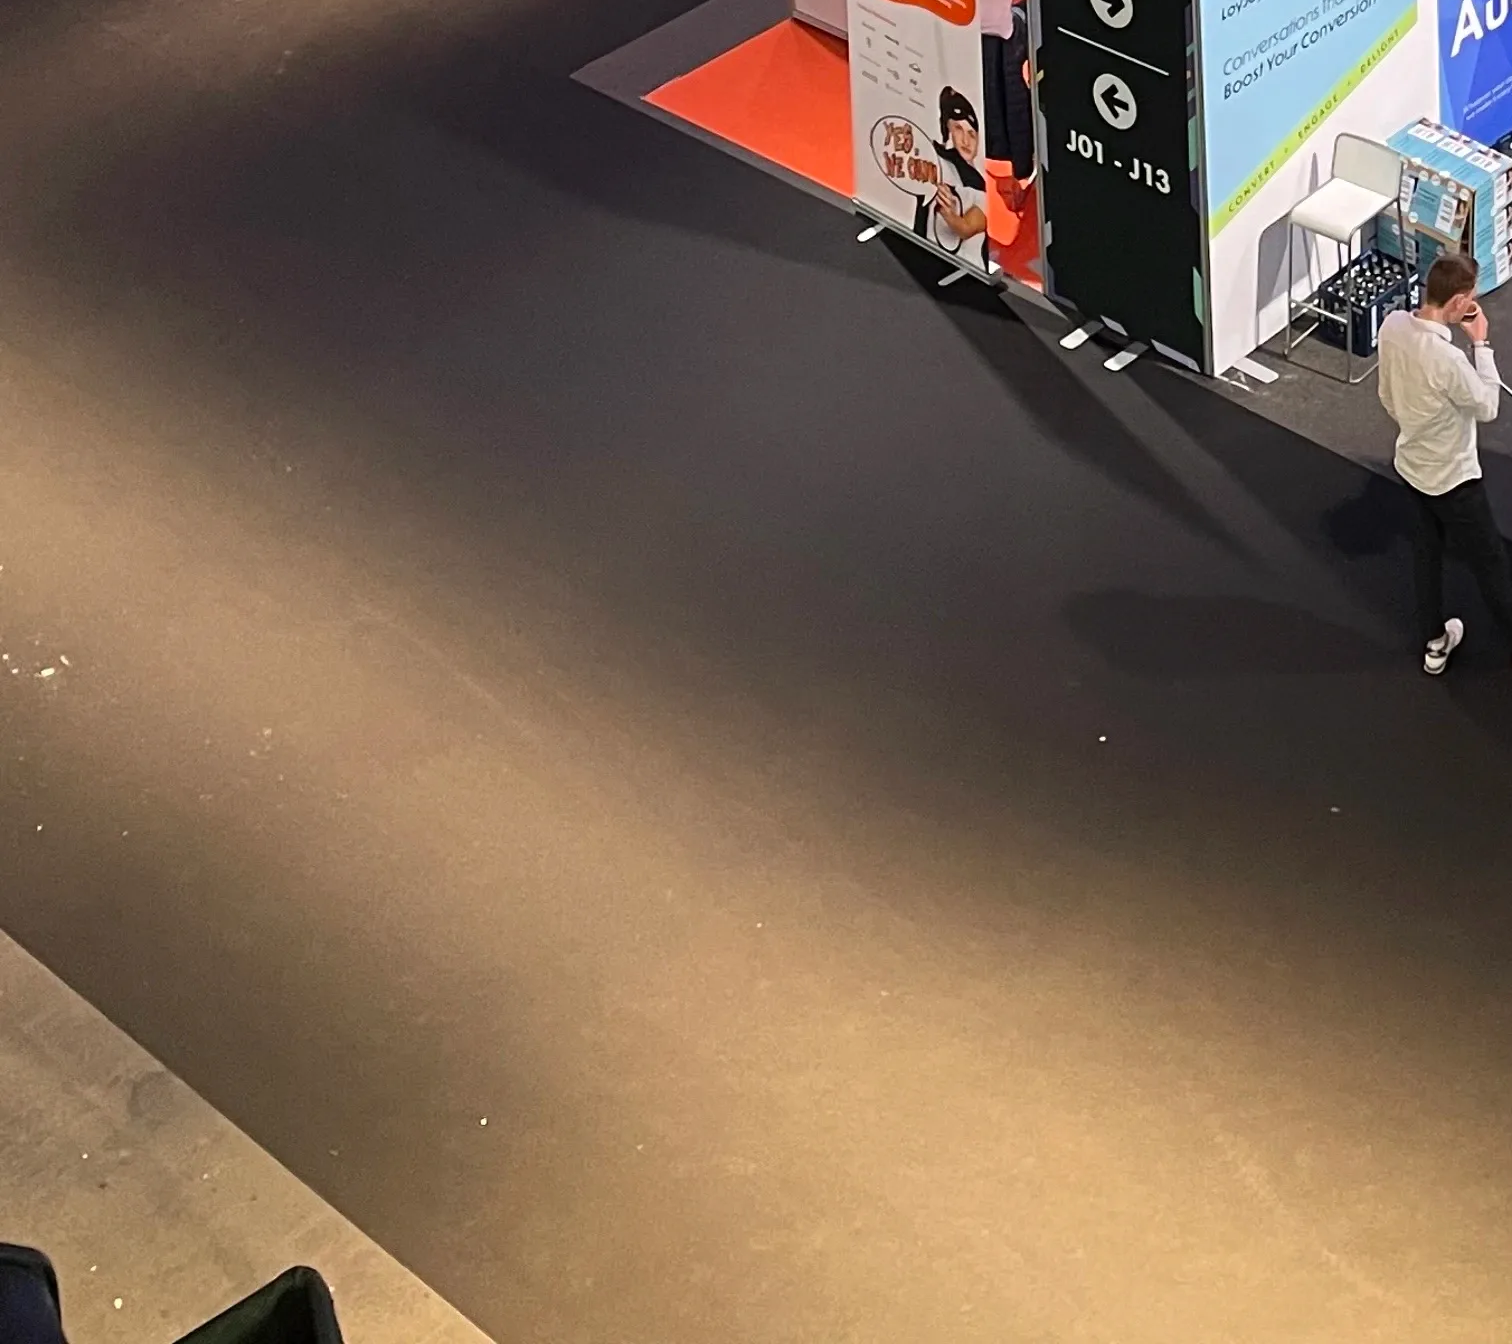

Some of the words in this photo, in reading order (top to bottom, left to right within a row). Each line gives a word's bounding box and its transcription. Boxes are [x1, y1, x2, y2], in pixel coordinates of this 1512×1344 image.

[1222, 6, 1320, 77] Conversations
[1266, 41, 1299, 72] Your
[1228, 159, 1277, 213] CONVERT
[1298, 93, 1340, 140] ENGAGE
[1359, 27, 1400, 74] DELIGHT
[1066, 128, 1105, 164] J01
[1127, 153, 1172, 195] J13
